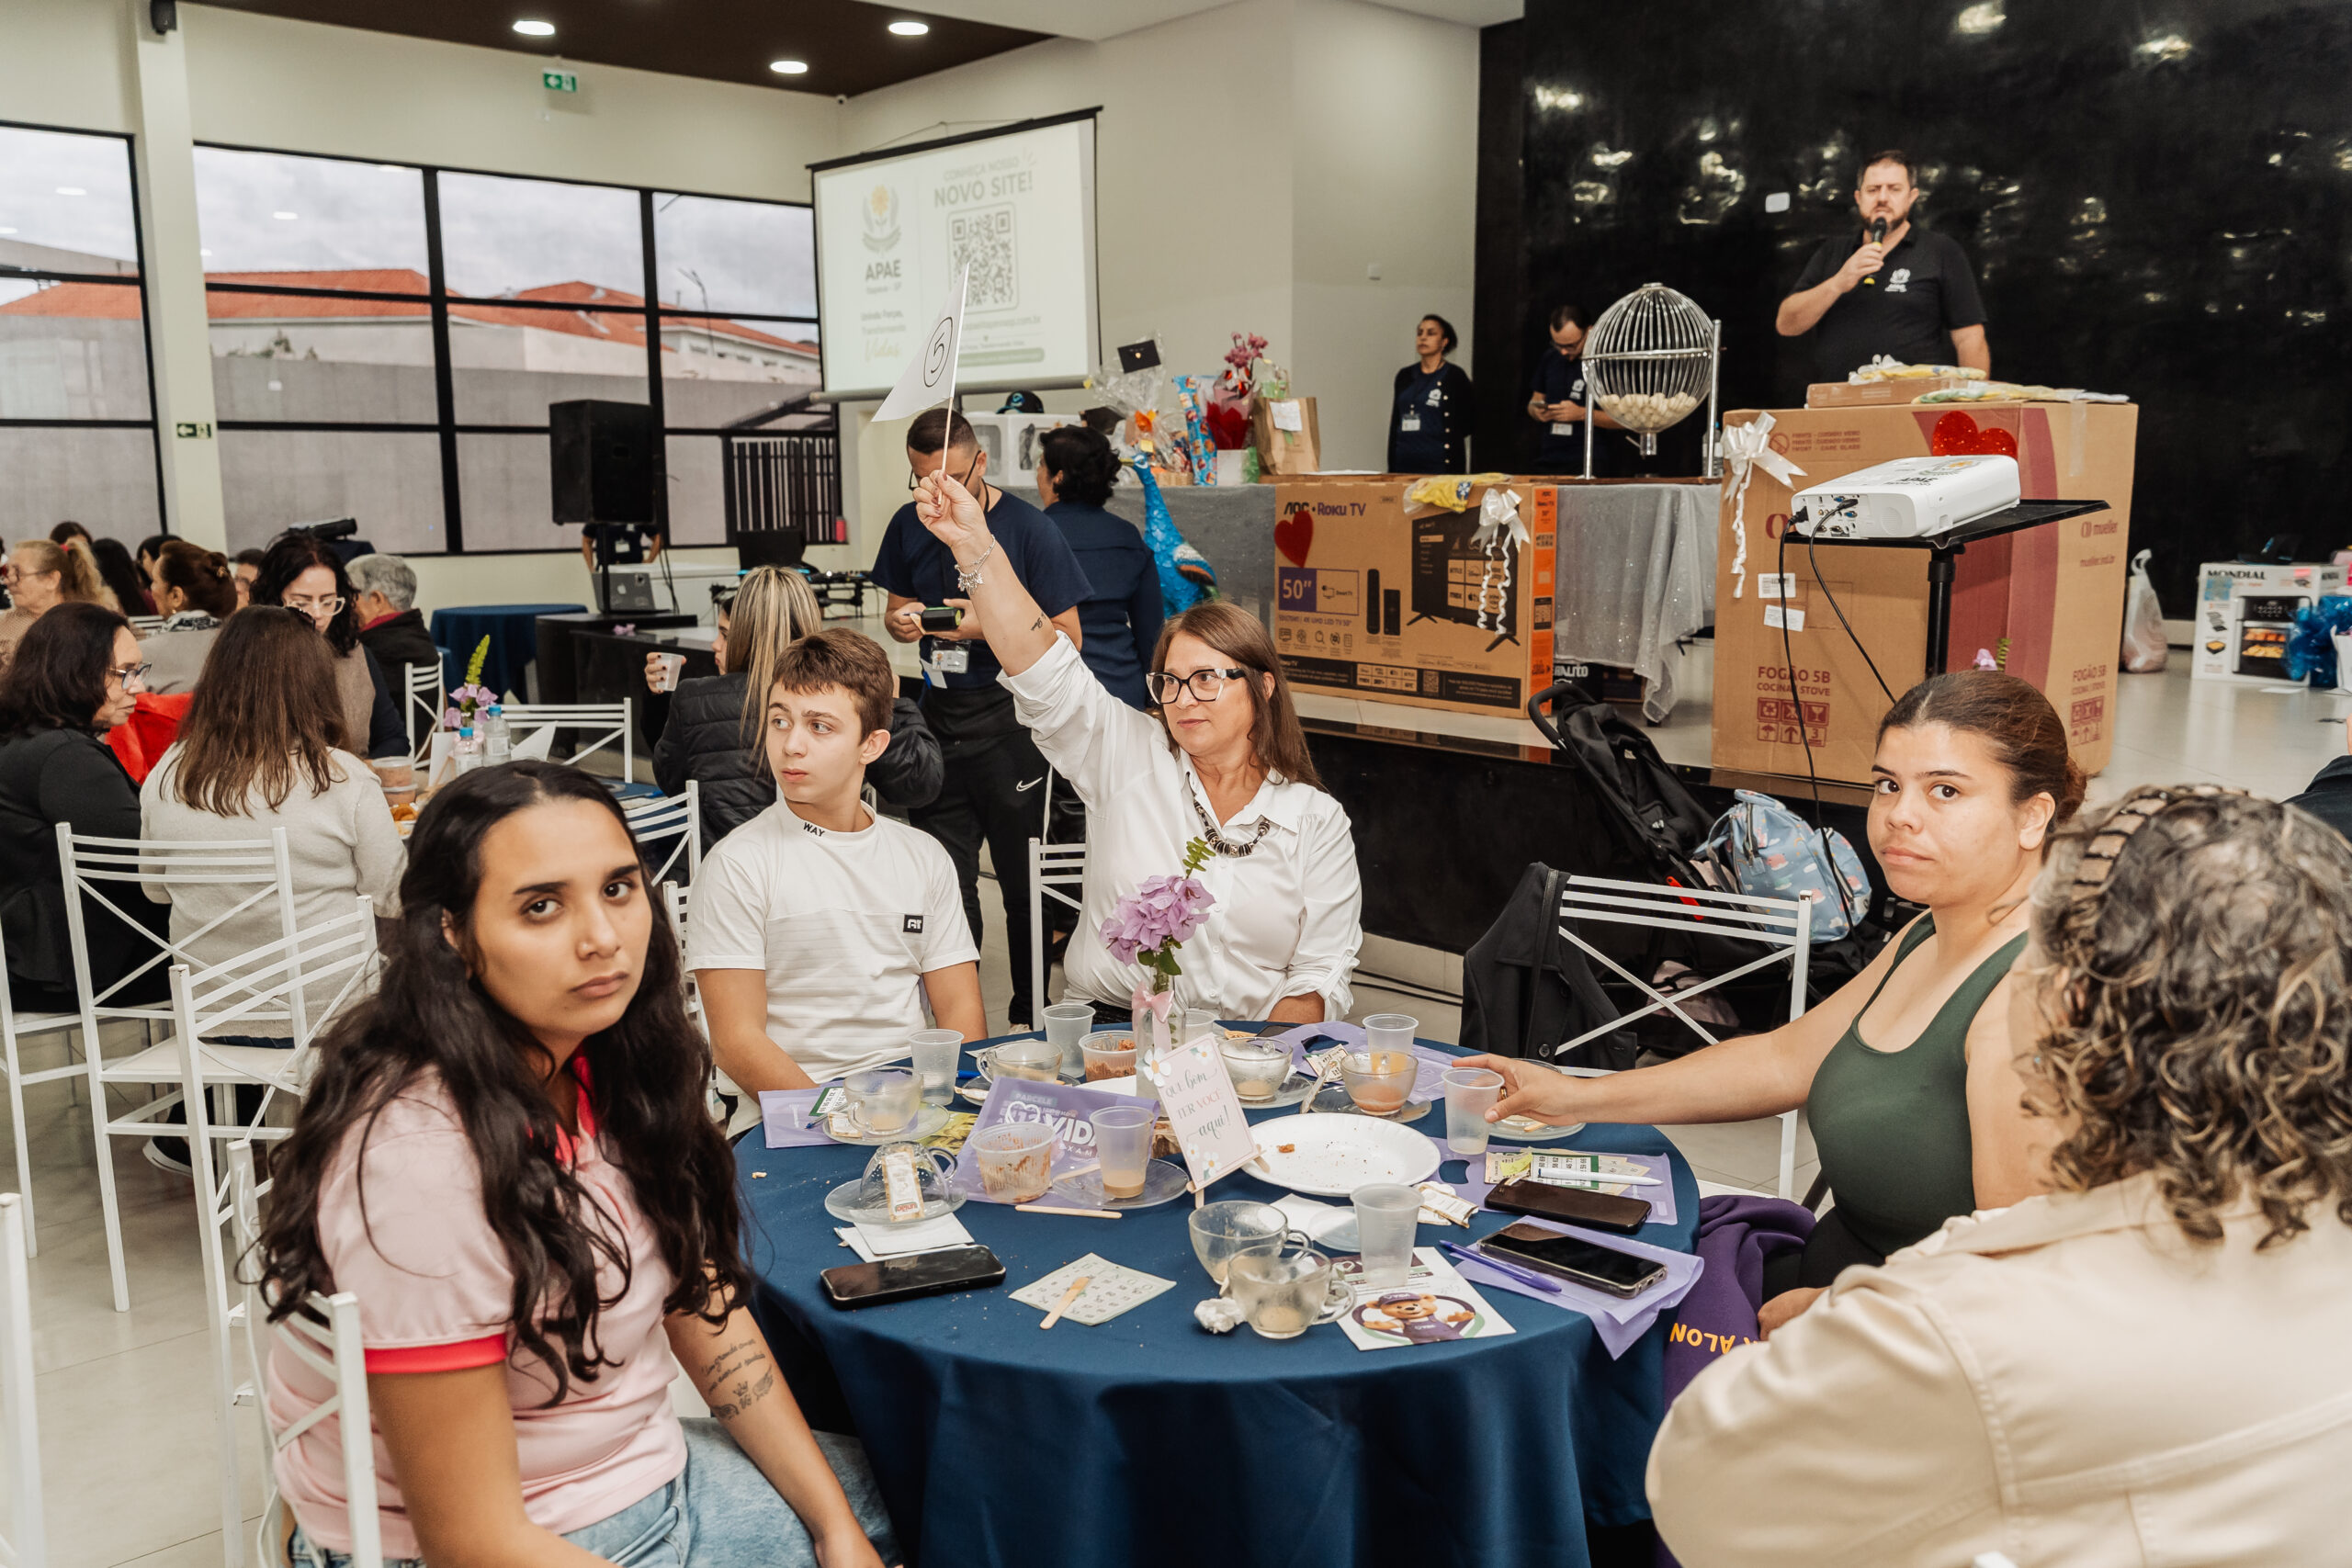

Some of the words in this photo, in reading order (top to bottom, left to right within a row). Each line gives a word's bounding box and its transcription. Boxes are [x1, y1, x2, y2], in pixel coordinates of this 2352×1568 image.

[934, 180, 985, 209] NOVO
[991, 170, 1033, 197] SITE!
[865, 259, 901, 281] APAE
[931, 332, 944, 374] 5
[1350, 502, 1366, 516] TV
[2208, 570, 2266, 580] MONDIAL
[1813, 671, 1831, 683] 5B
[1800, 686, 1831, 696] STOVE
[1811, 728, 1819, 739] 3
[803, 822, 825, 837] WAY
[1184, 1068, 1209, 1089] bom
